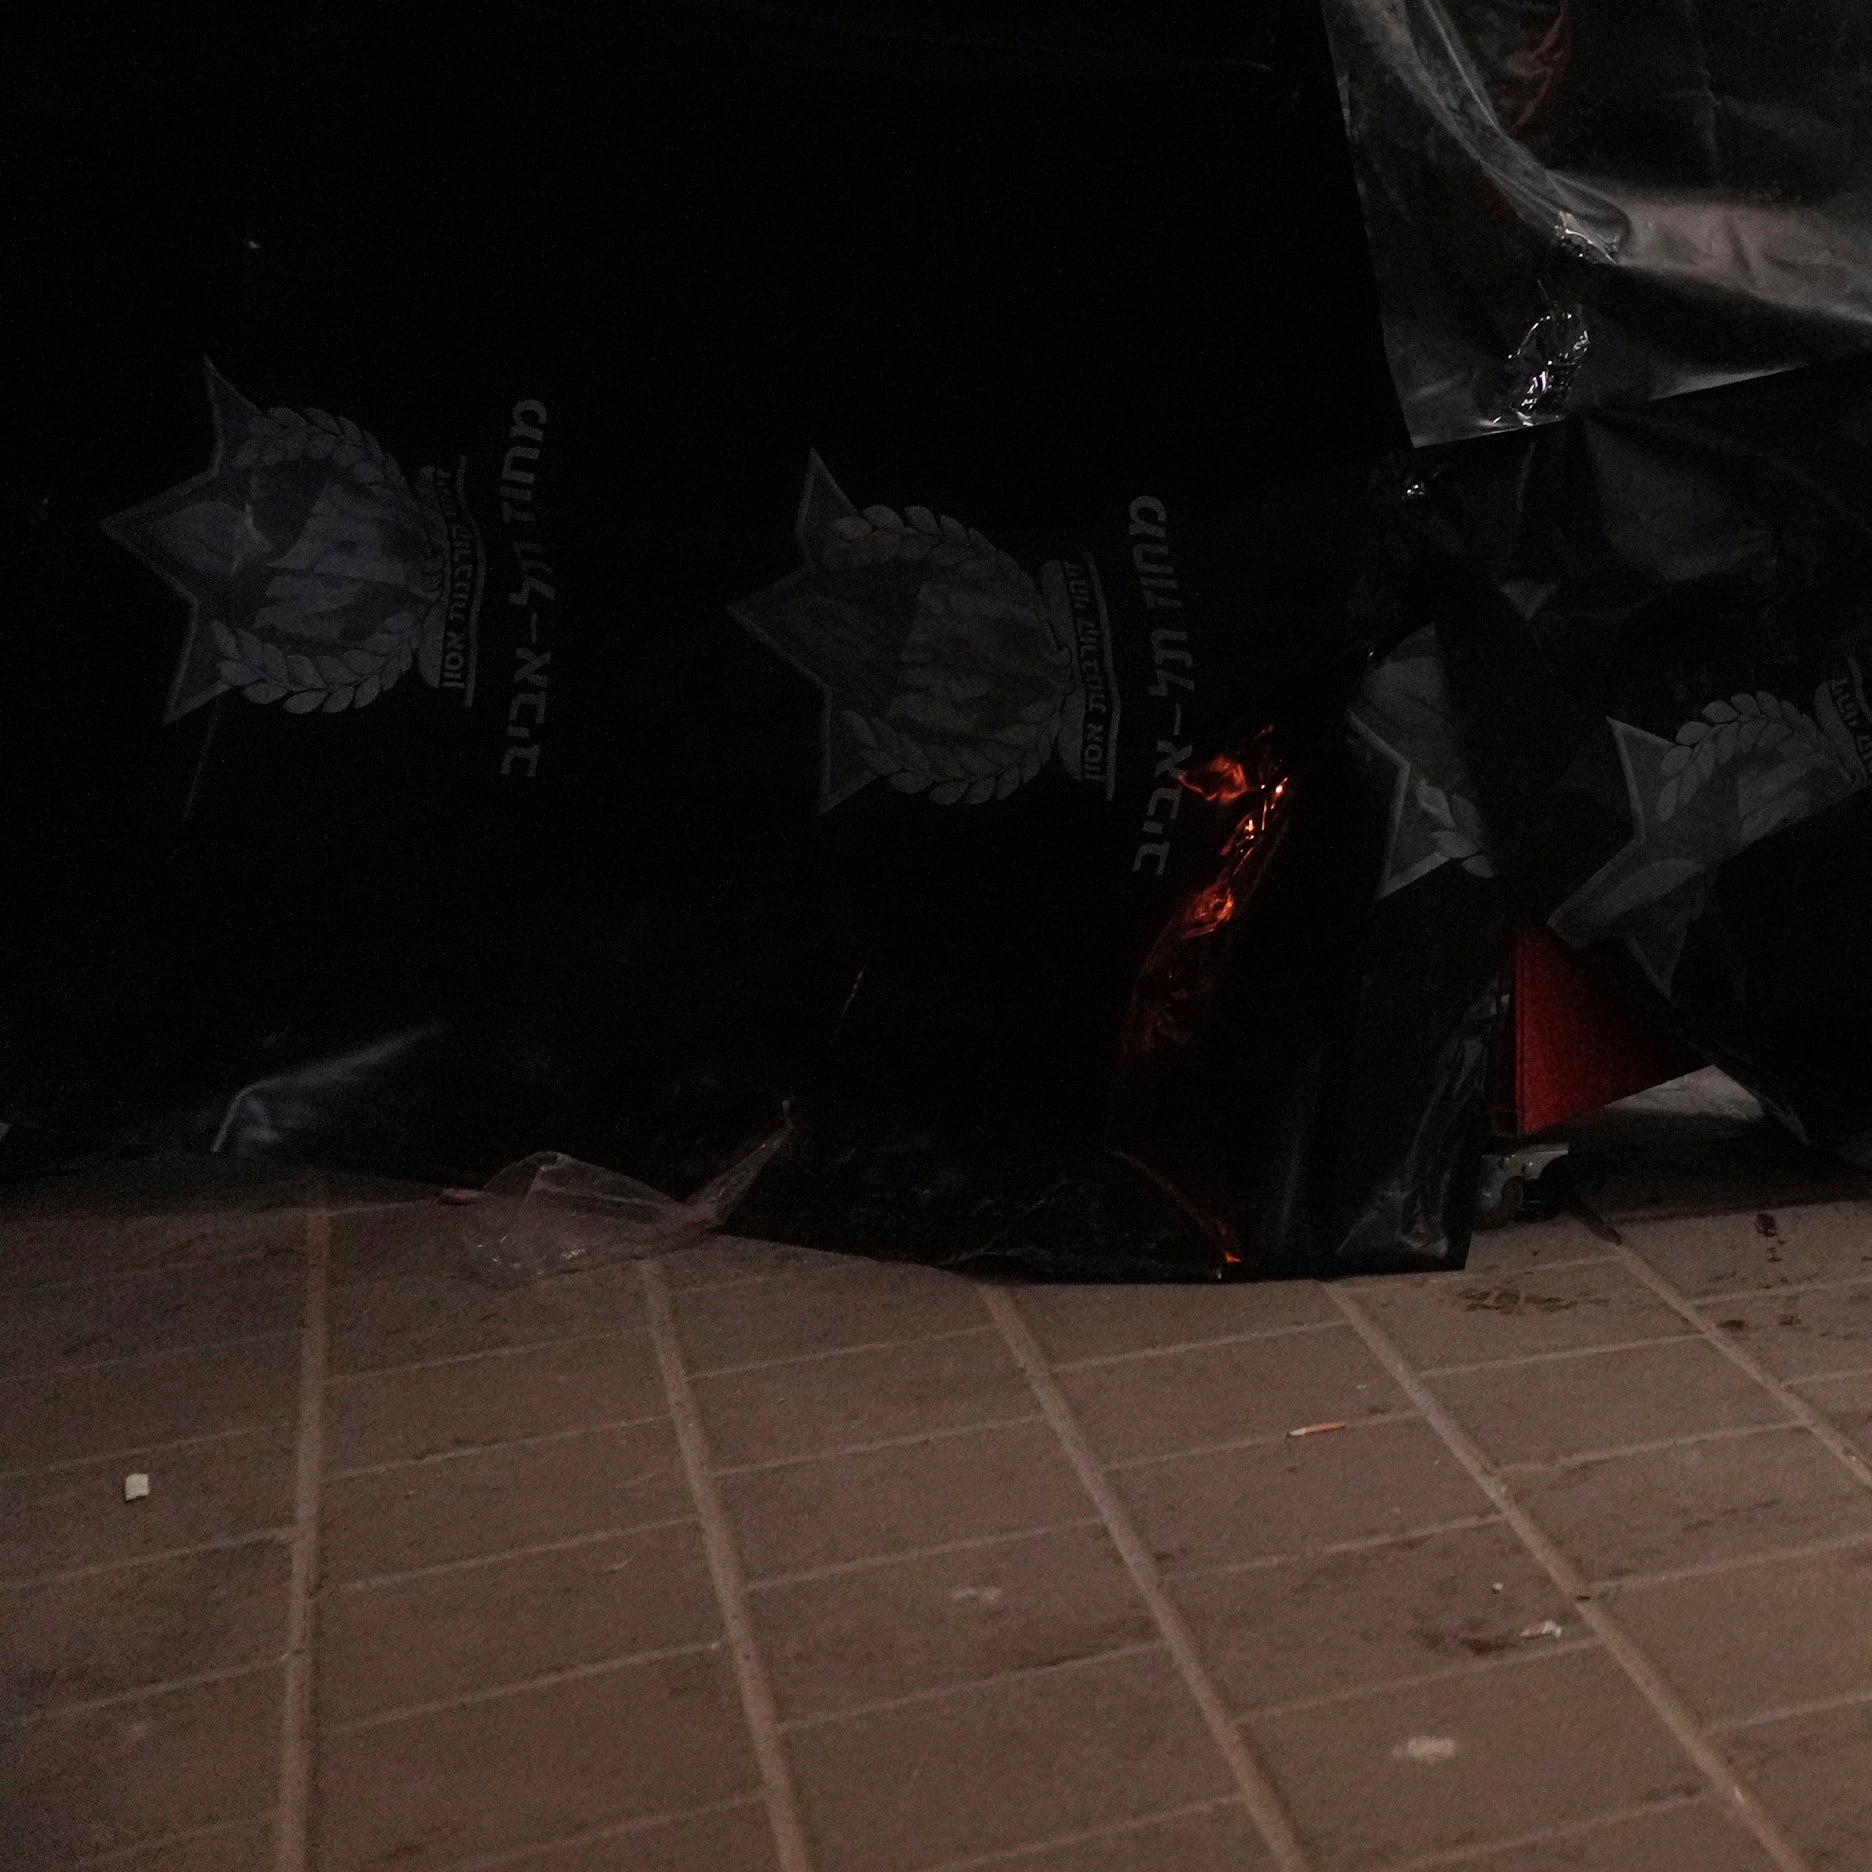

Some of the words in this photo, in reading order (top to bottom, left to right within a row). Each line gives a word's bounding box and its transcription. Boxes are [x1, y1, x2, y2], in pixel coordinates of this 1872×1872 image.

[499, 398, 548, 524] מחוז
[1128, 494, 1182, 610] מחוז
[442, 629, 466, 689] אסון
[501, 540, 556, 779] תל-אביב
[1081, 721, 1108, 782] אסון
[1132, 628, 1195, 876] תל-אביב
